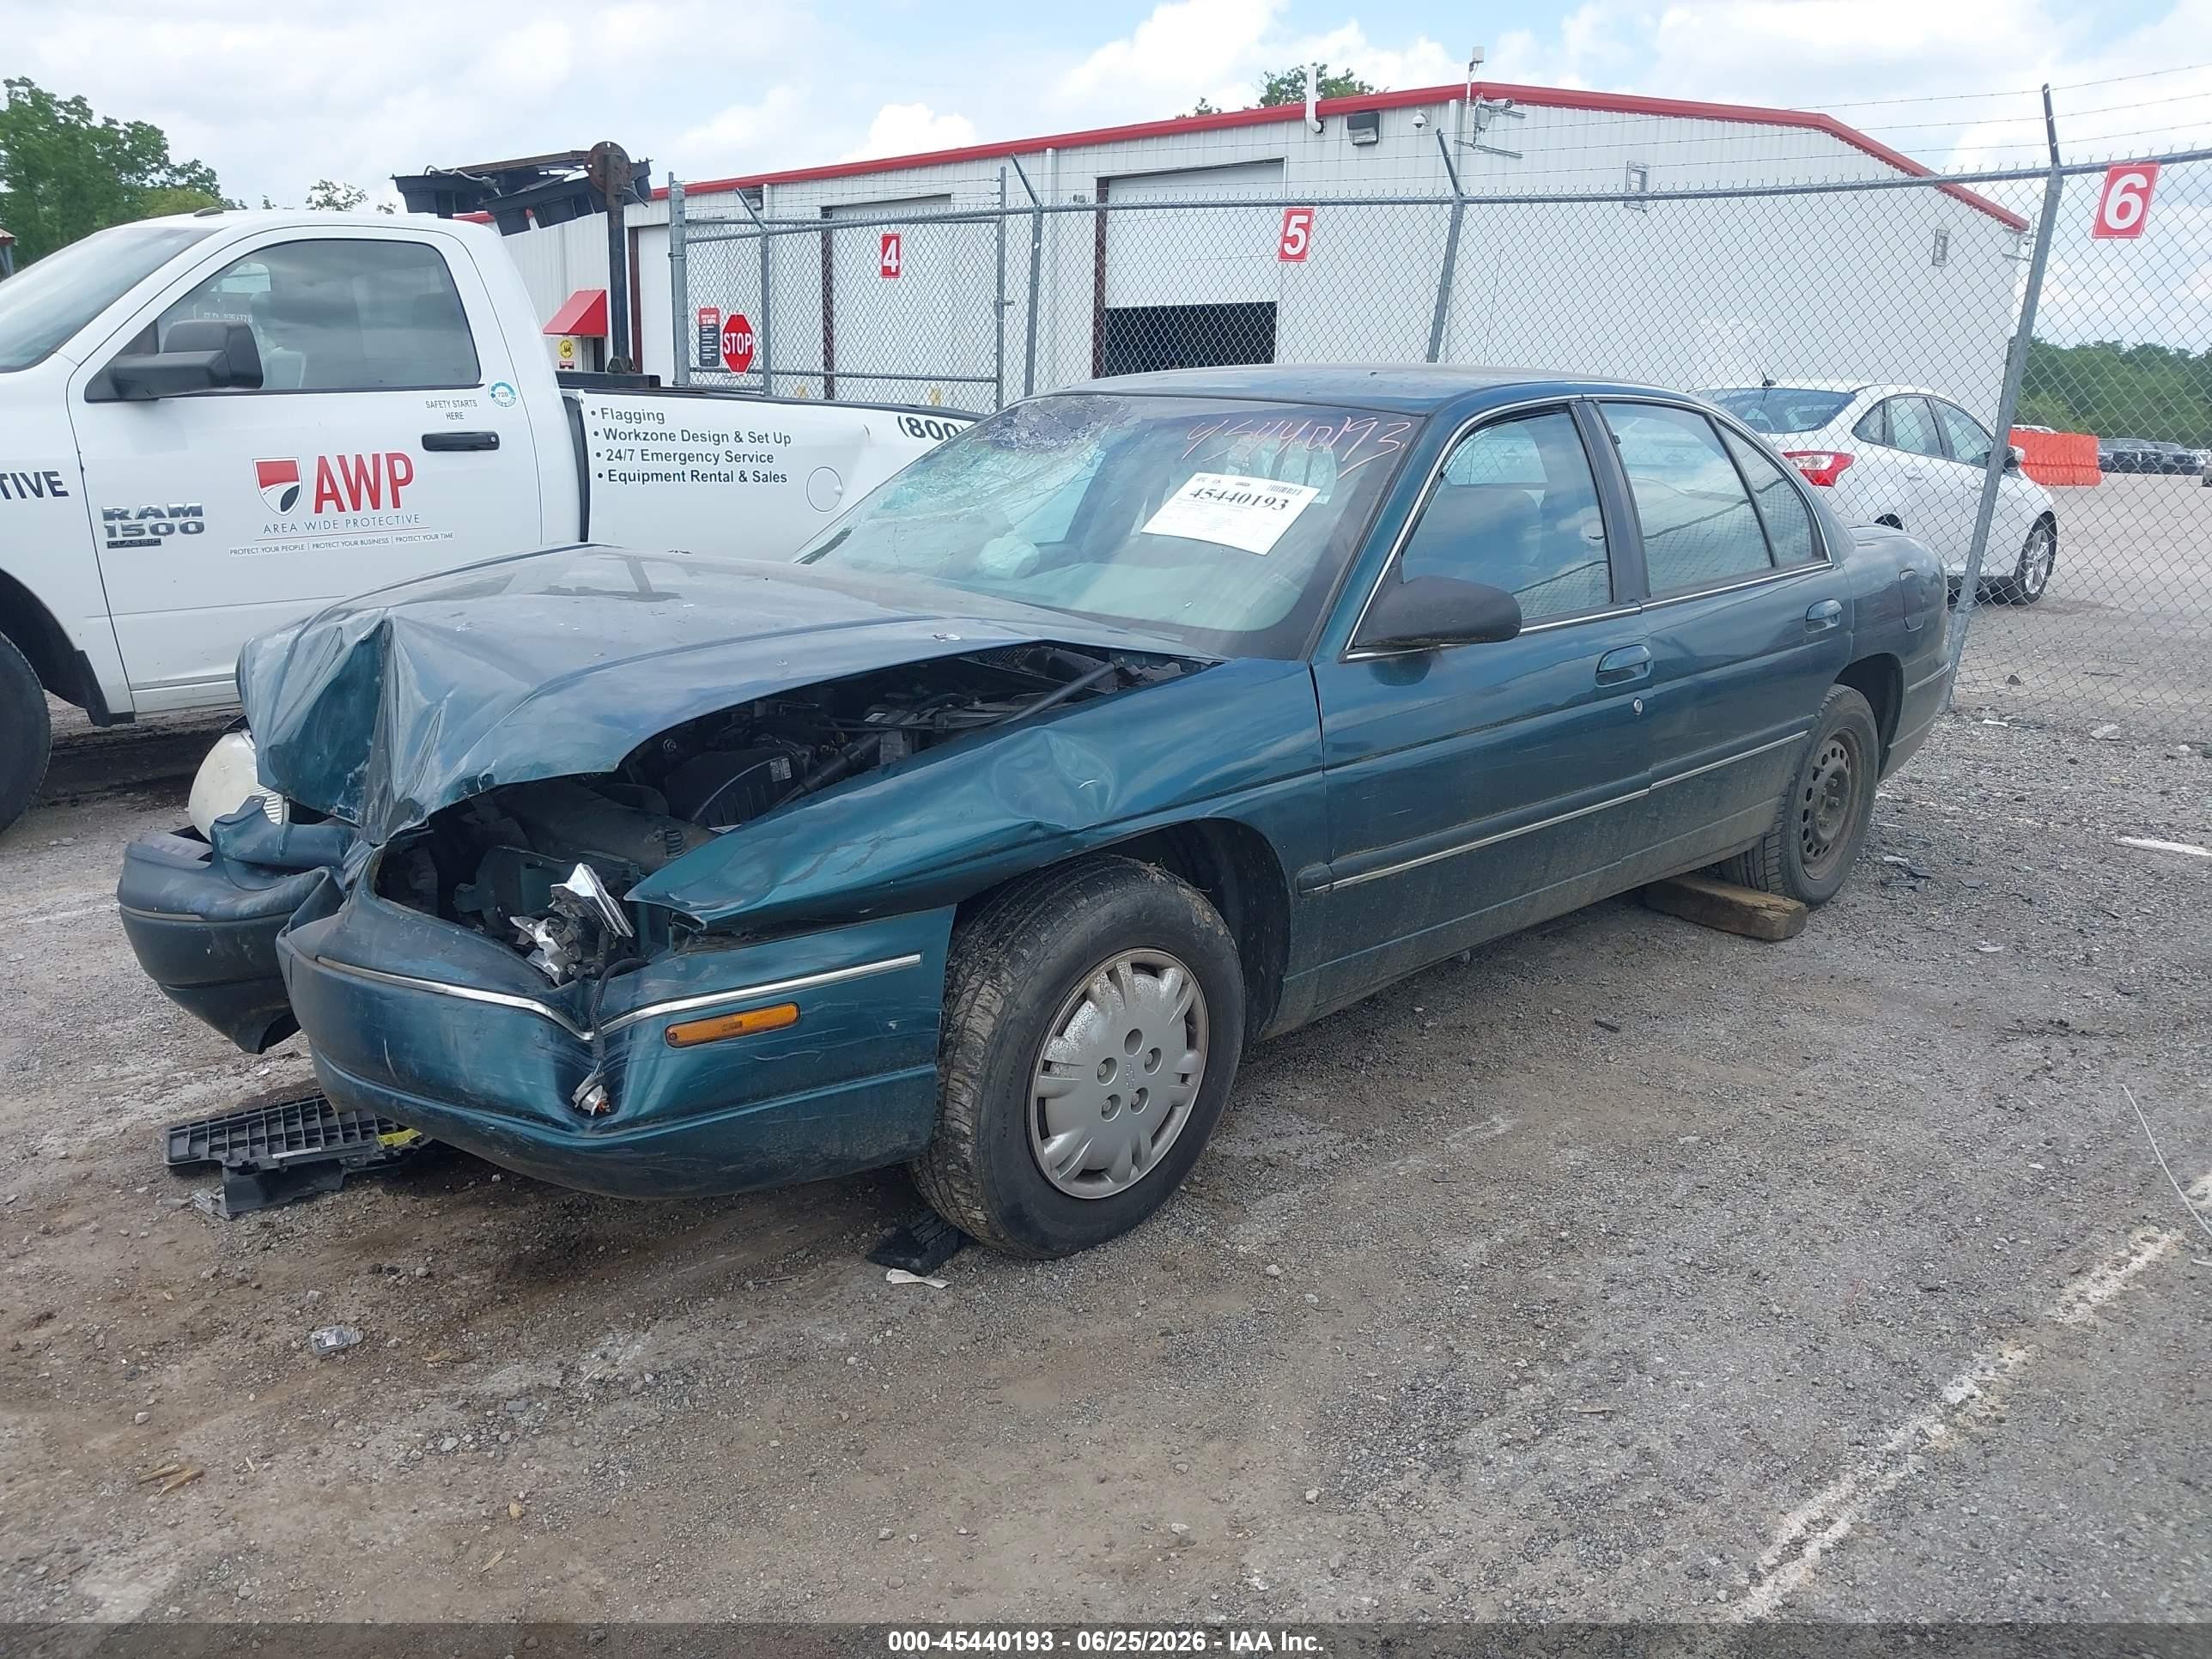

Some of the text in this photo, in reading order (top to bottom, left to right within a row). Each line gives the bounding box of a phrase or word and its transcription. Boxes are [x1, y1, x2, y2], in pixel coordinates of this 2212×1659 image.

[2105, 173, 2148, 230] 6
[1284, 215, 1309, 256] 5
[883, 239, 899, 273] 4
[723, 332, 752, 355] STOP
[425, 398, 477, 409] SAFETY STARTS
[446, 411, 465, 420] HERE
[600, 407, 665, 425] Flagging
[603, 428, 792, 446] Workzone Design & Set Up
[897, 416, 964, 441] (800
[605, 448, 775, 465] 24/7 Emergency Service
[0, 471, 70, 500] TIVE
[313, 452, 414, 514] AWP
[607, 469, 788, 485] Equipment Rental & Sales
[1189, 487, 1290, 511] 45440193
[102, 501, 204, 521] RAM
[104, 519, 205, 538] 1500
[263, 514, 421, 534] AREA WIDE PROTECTIVE
[108, 538, 161, 548] CLASSIC
[312, 541, 339, 550] PROTECT
[360, 538, 389, 546] BUSINESS
[395, 534, 421, 543] PROTECT
[229, 543, 305, 556] PROTECT YOUR PEOPLE
